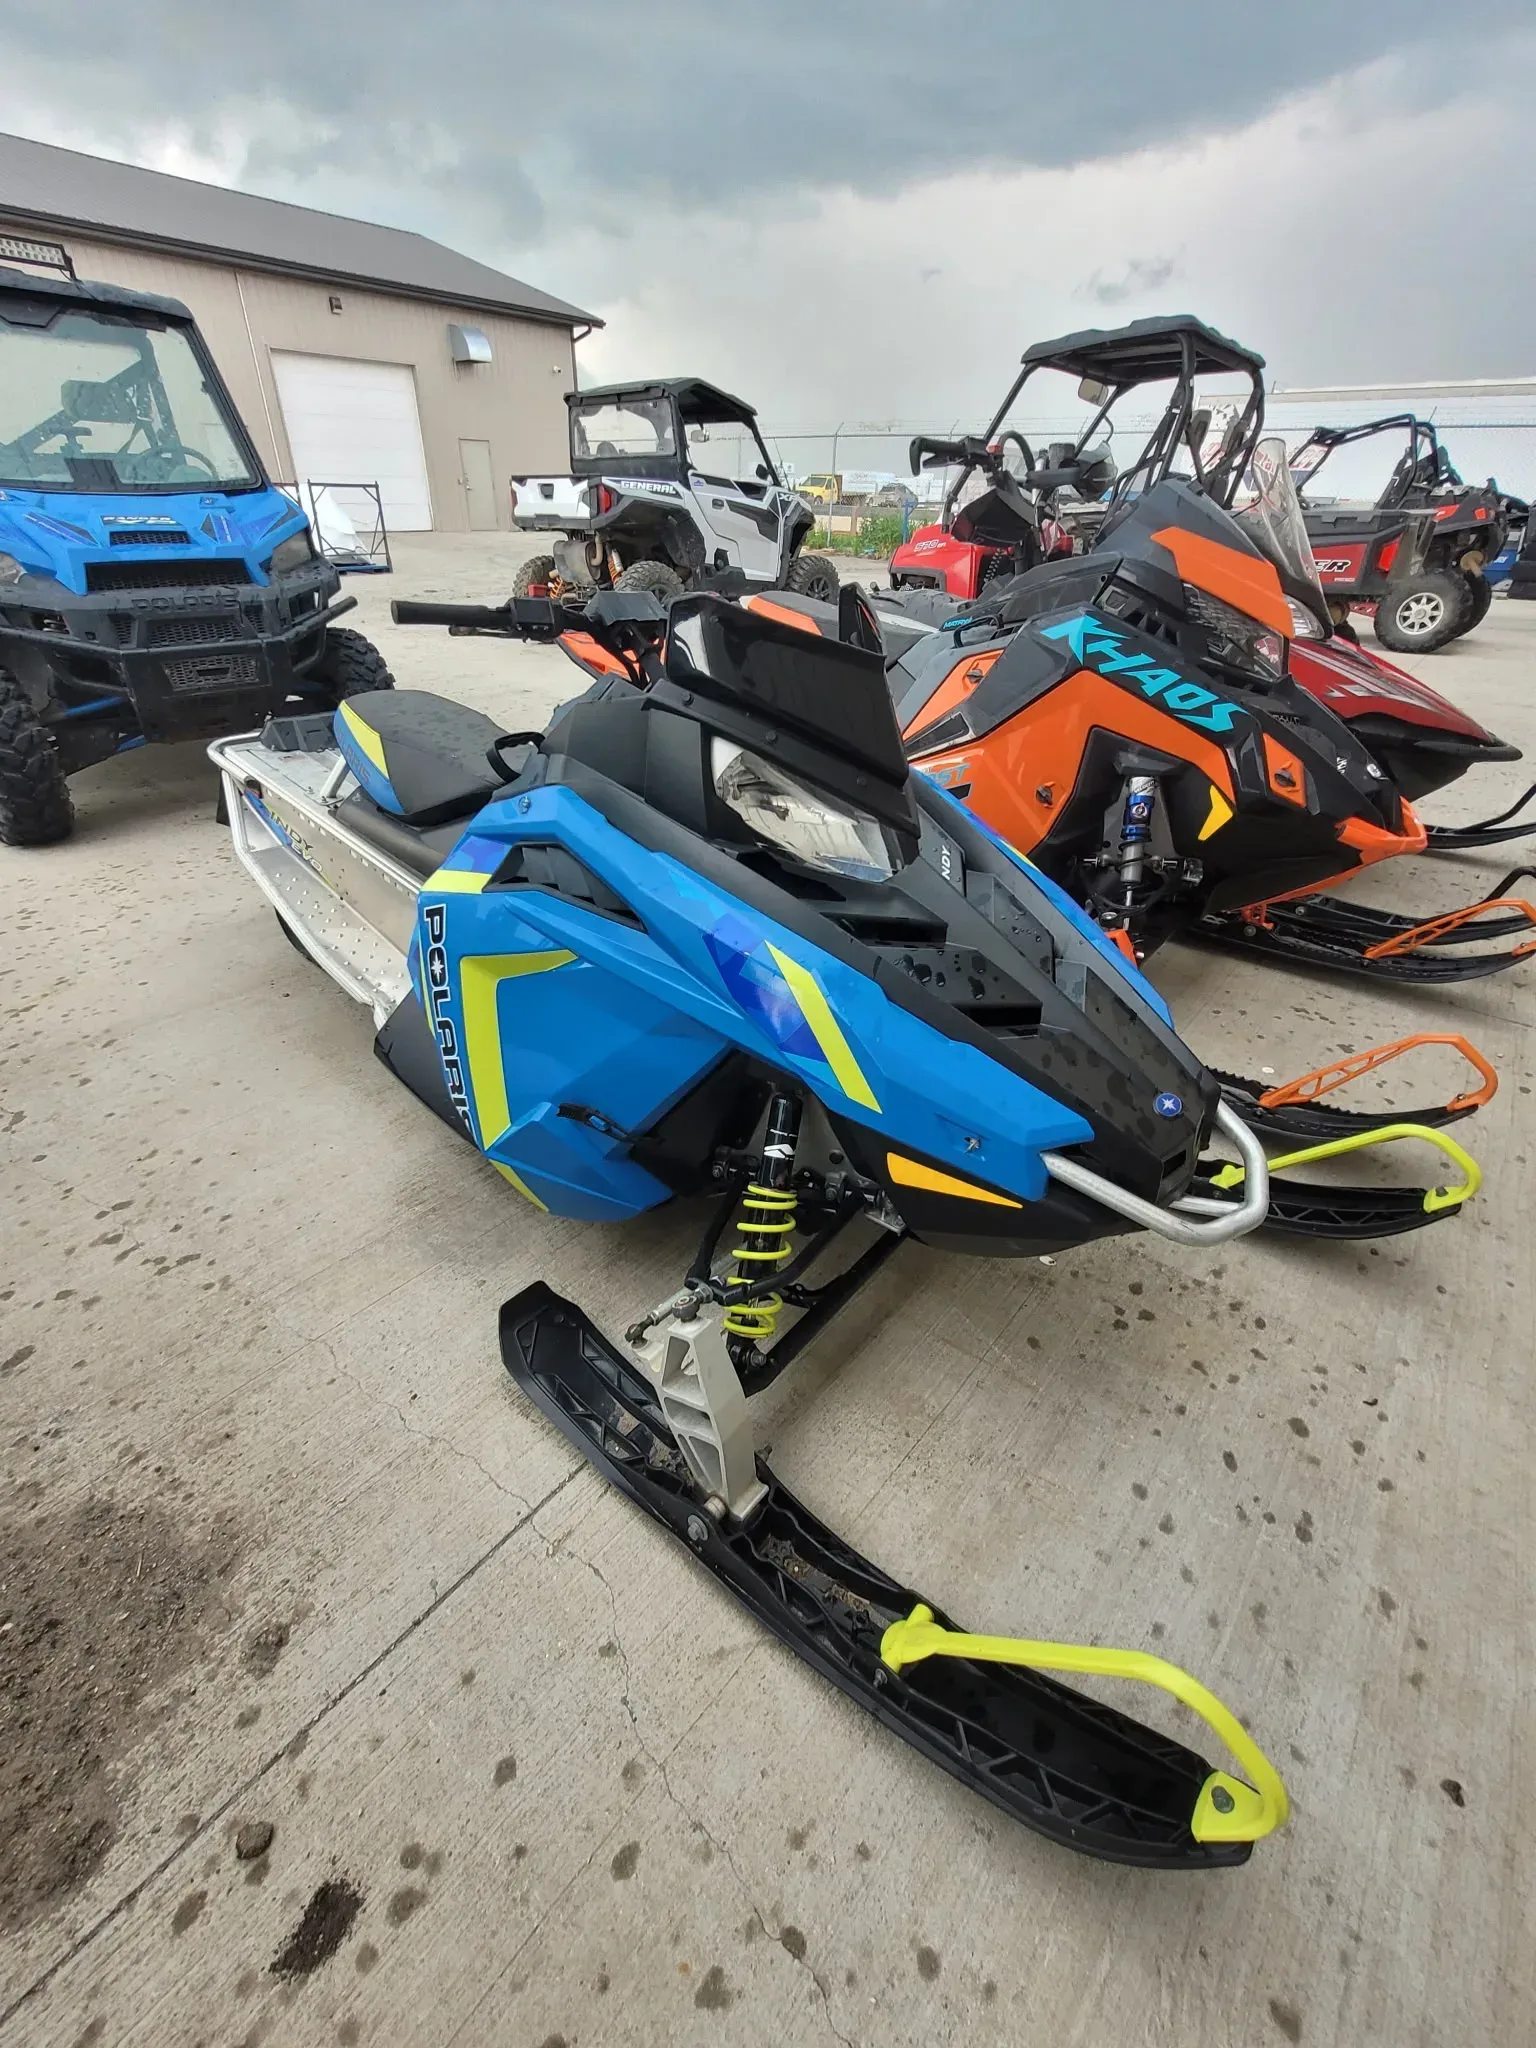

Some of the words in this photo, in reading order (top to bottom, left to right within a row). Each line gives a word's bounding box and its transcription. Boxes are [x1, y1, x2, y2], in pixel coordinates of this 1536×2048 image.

[620, 480, 677, 495] GENERAL
[131, 593, 239, 611] POLARIS
[1040, 614, 1249, 733] KHAOS
[270, 811, 314, 852] INDY
[291, 842, 323, 872] EVO
